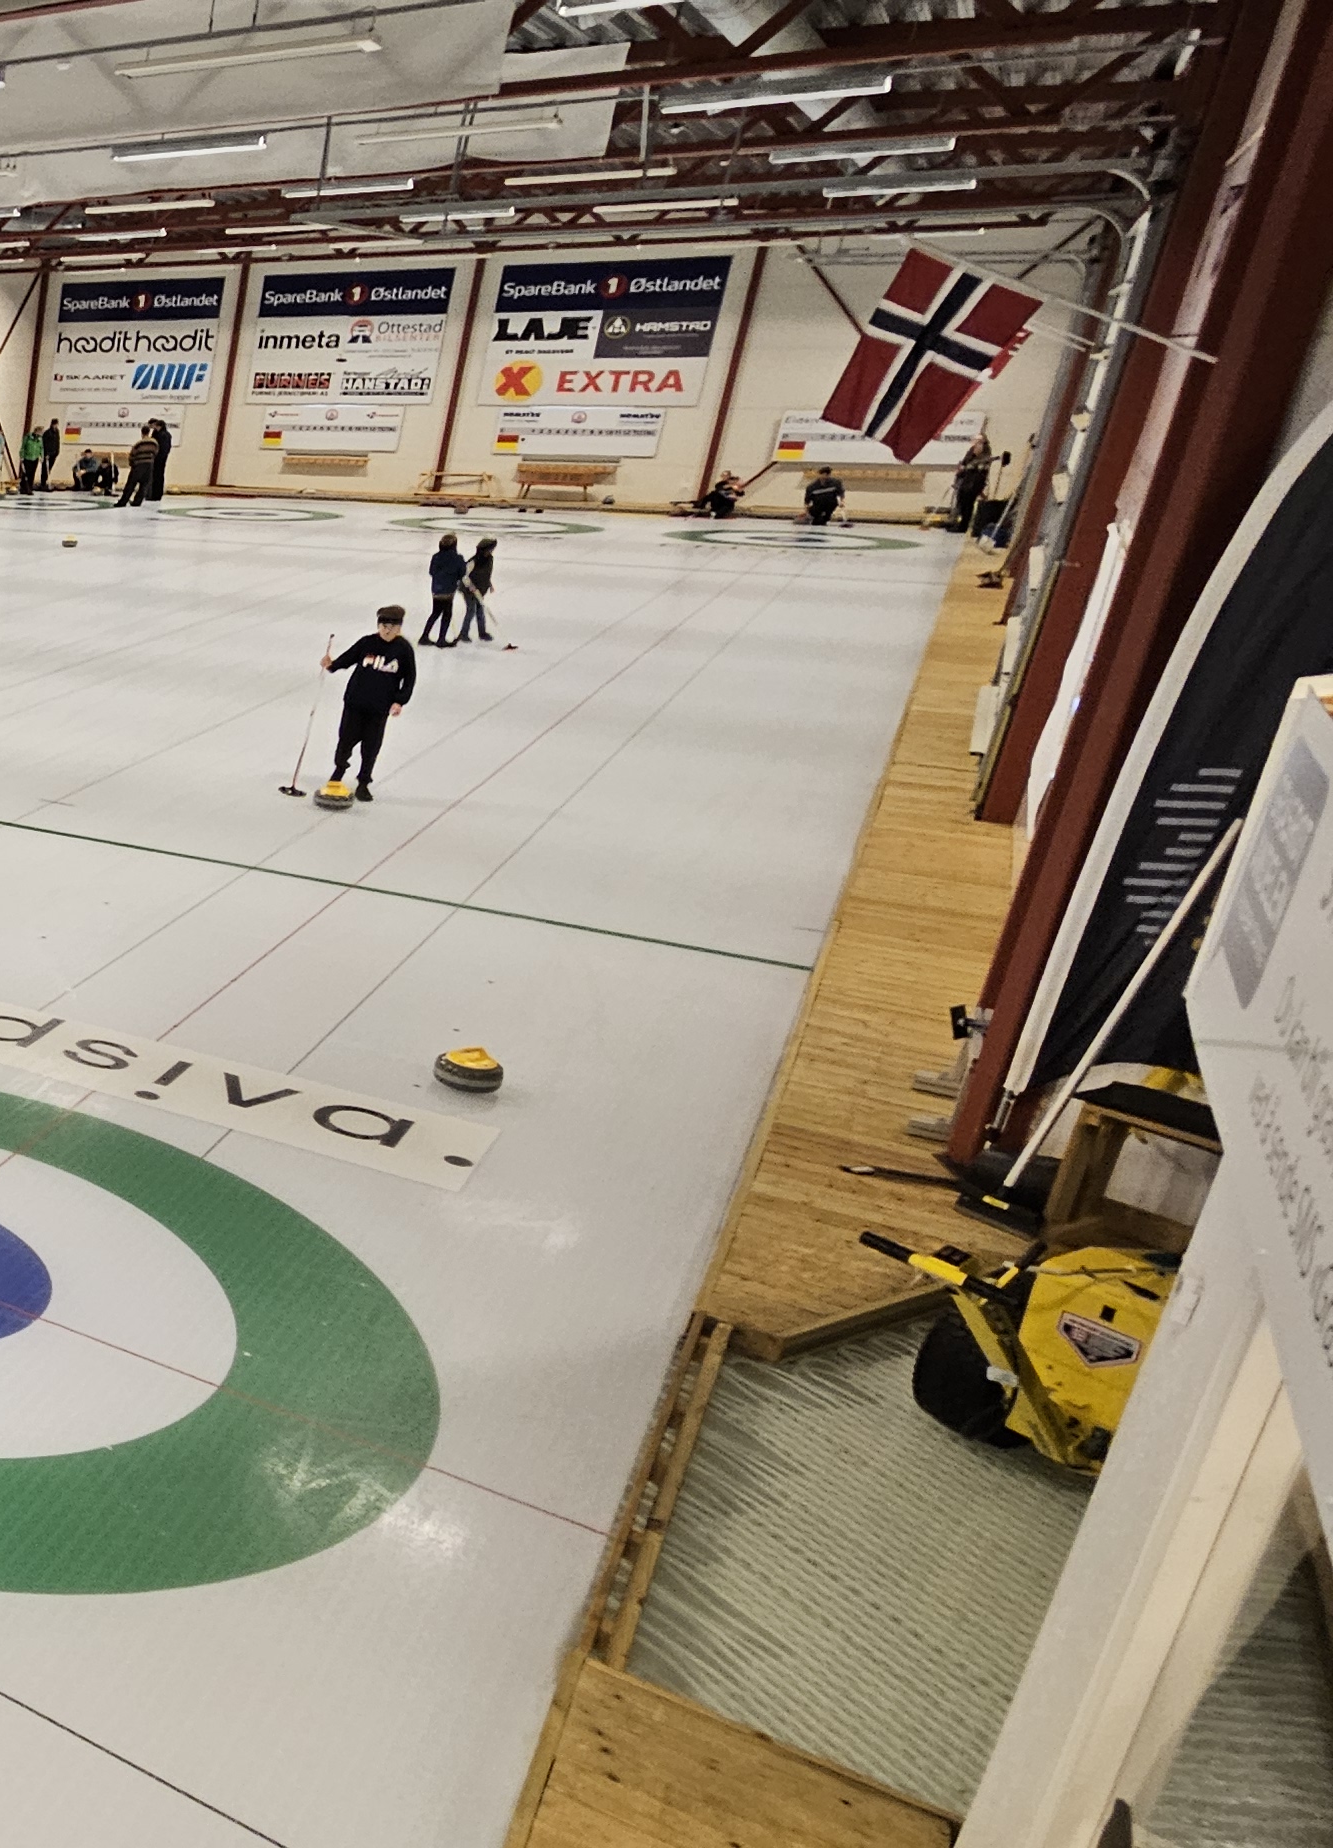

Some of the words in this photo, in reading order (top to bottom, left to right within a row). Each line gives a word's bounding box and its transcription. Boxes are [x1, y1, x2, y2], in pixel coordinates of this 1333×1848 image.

[264, 288, 343, 306] SpareBank
[351, 286, 362, 301] 1
[370, 285, 447, 301] Østlandet
[502, 279, 597, 299] SpareBank
[607, 276, 619, 294] 1
[629, 275, 722, 293] Østlandet
[63, 296, 131, 312] SpareBank
[138, 294, 146, 308] 1
[153, 293, 218, 308] Østlandet
[377, 319, 444, 334] Ottestad
[492, 316, 593, 342] LAJE
[257, 329, 341, 350] inmeta
[253, 372, 332, 390] FURNES
[341, 377, 424, 391] HANSTAD
[556, 369, 685, 393] EXTRA
[362, 653, 400, 674] FILA
